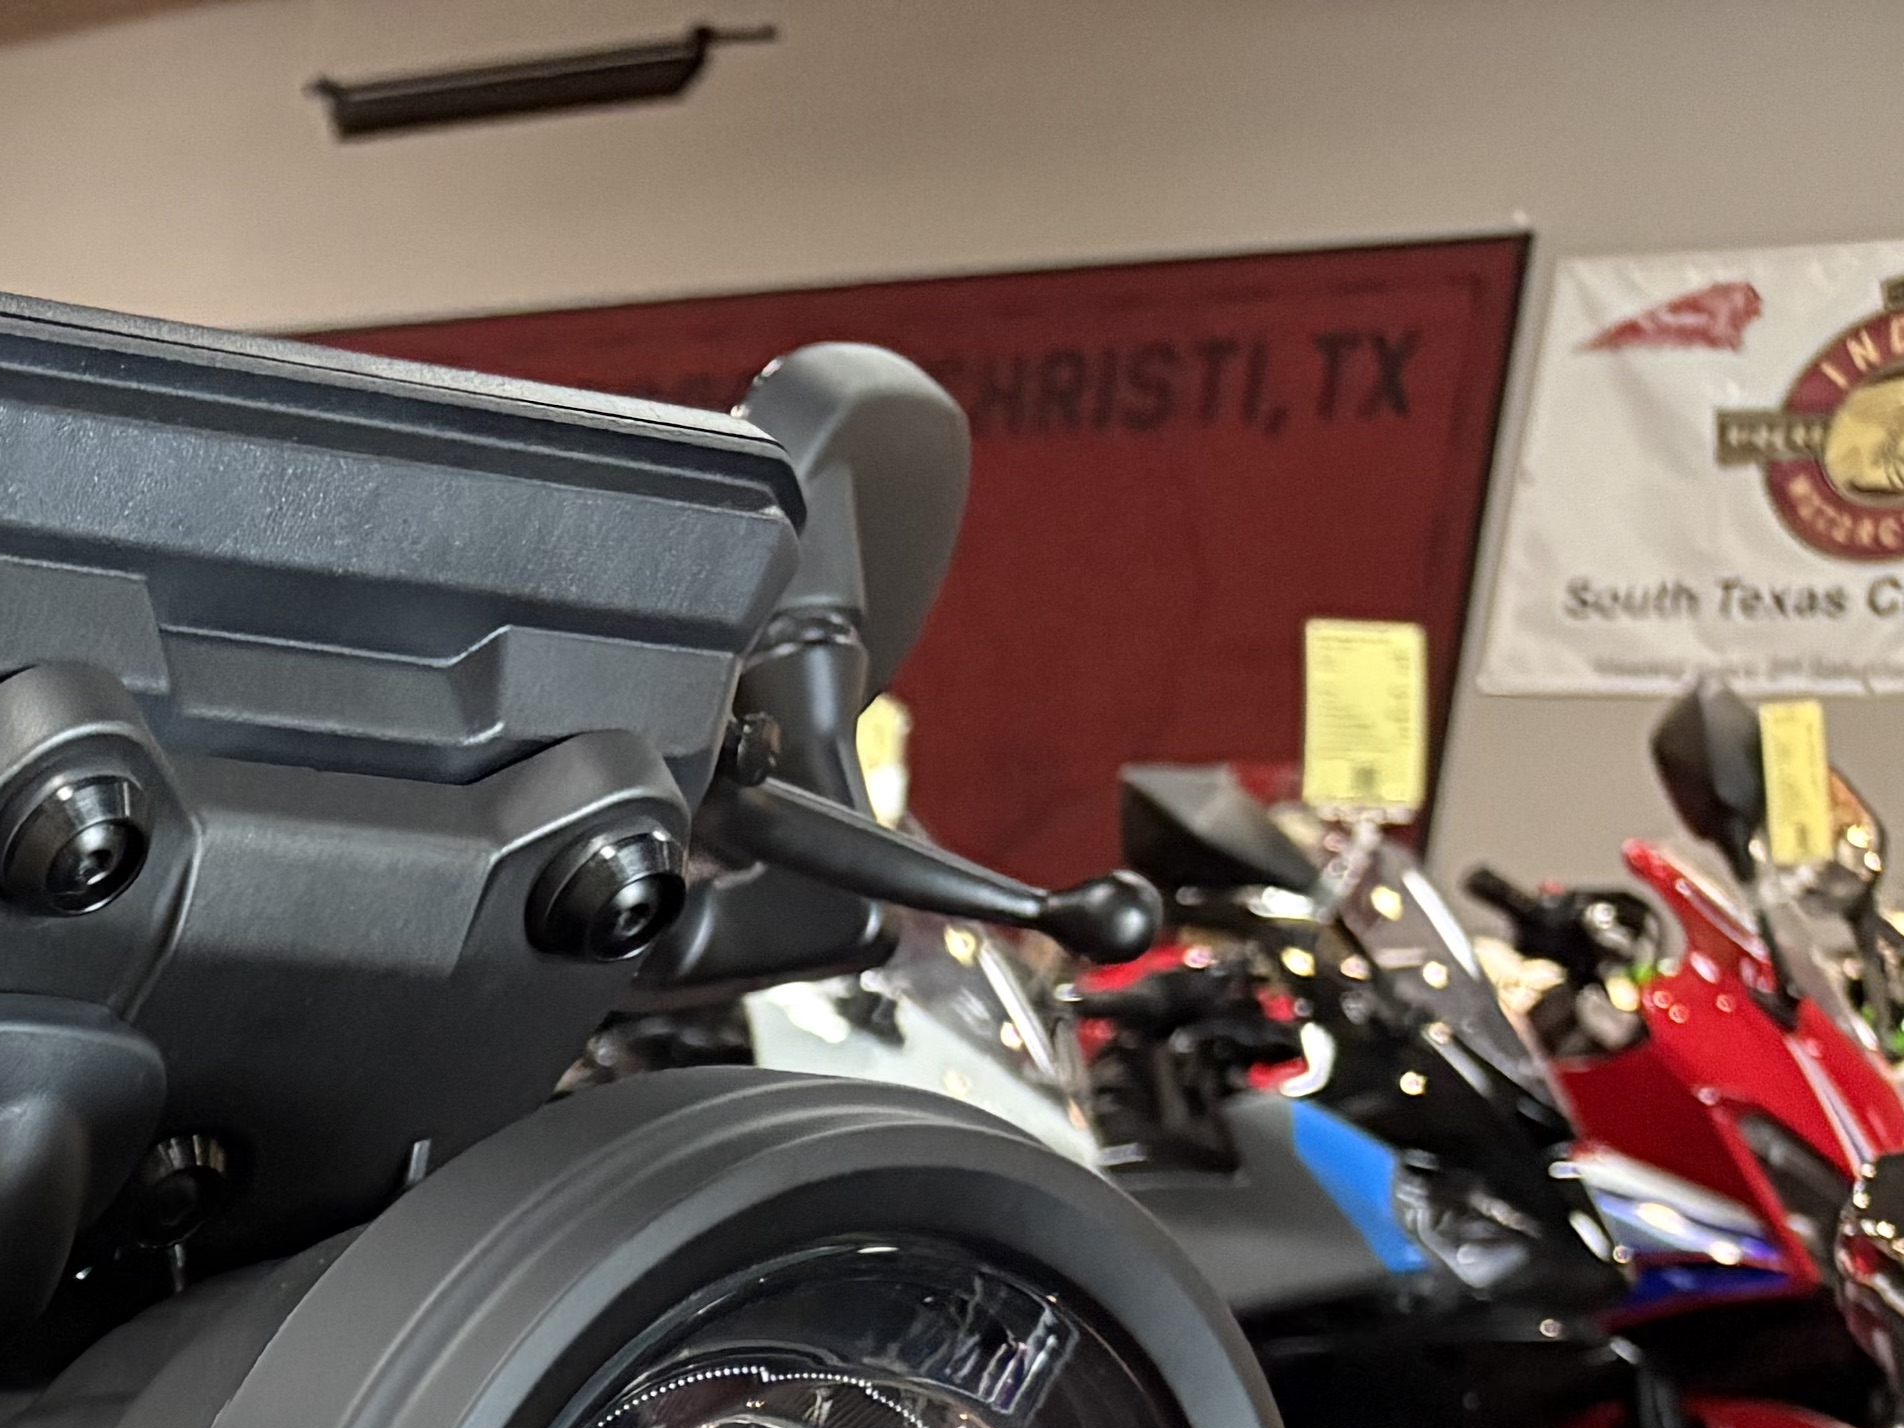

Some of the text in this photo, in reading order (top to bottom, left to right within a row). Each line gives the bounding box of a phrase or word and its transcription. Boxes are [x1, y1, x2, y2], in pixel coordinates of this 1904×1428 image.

[932, 326, 1423, 436] HRISTI, TX
[1562, 576, 1699, 620] South
[1716, 576, 1848, 620] Texas
